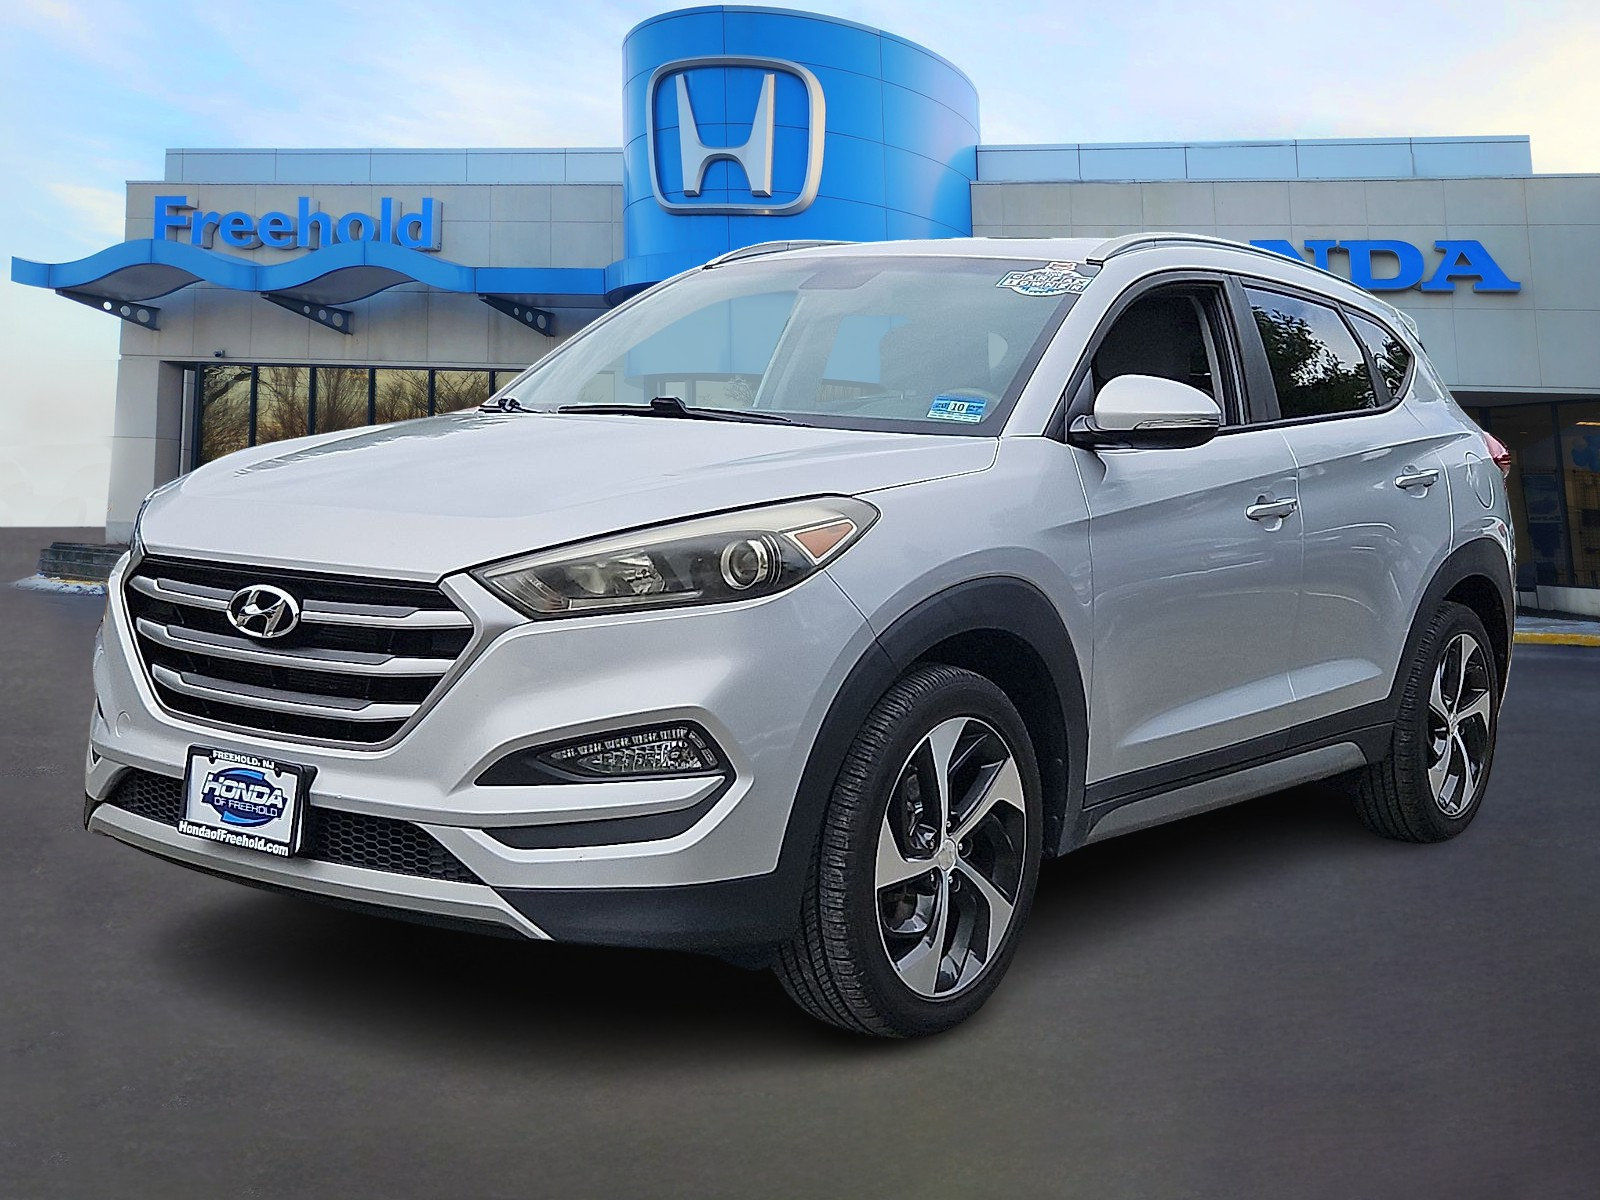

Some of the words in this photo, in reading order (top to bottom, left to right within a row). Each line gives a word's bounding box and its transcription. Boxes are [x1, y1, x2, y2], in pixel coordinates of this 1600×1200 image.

[153, 195, 439, 250] Freehold
[950, 402, 966, 412] 10
[212, 749, 261, 767] FREEHOLD,
[262, 759, 275, 769] NJ
[203, 774, 284, 808] HONDA
[214, 796, 227, 807] OF
[228, 799, 278, 817] FREEHOLD
[178, 820, 289, 857] HondaofFreehold.com
